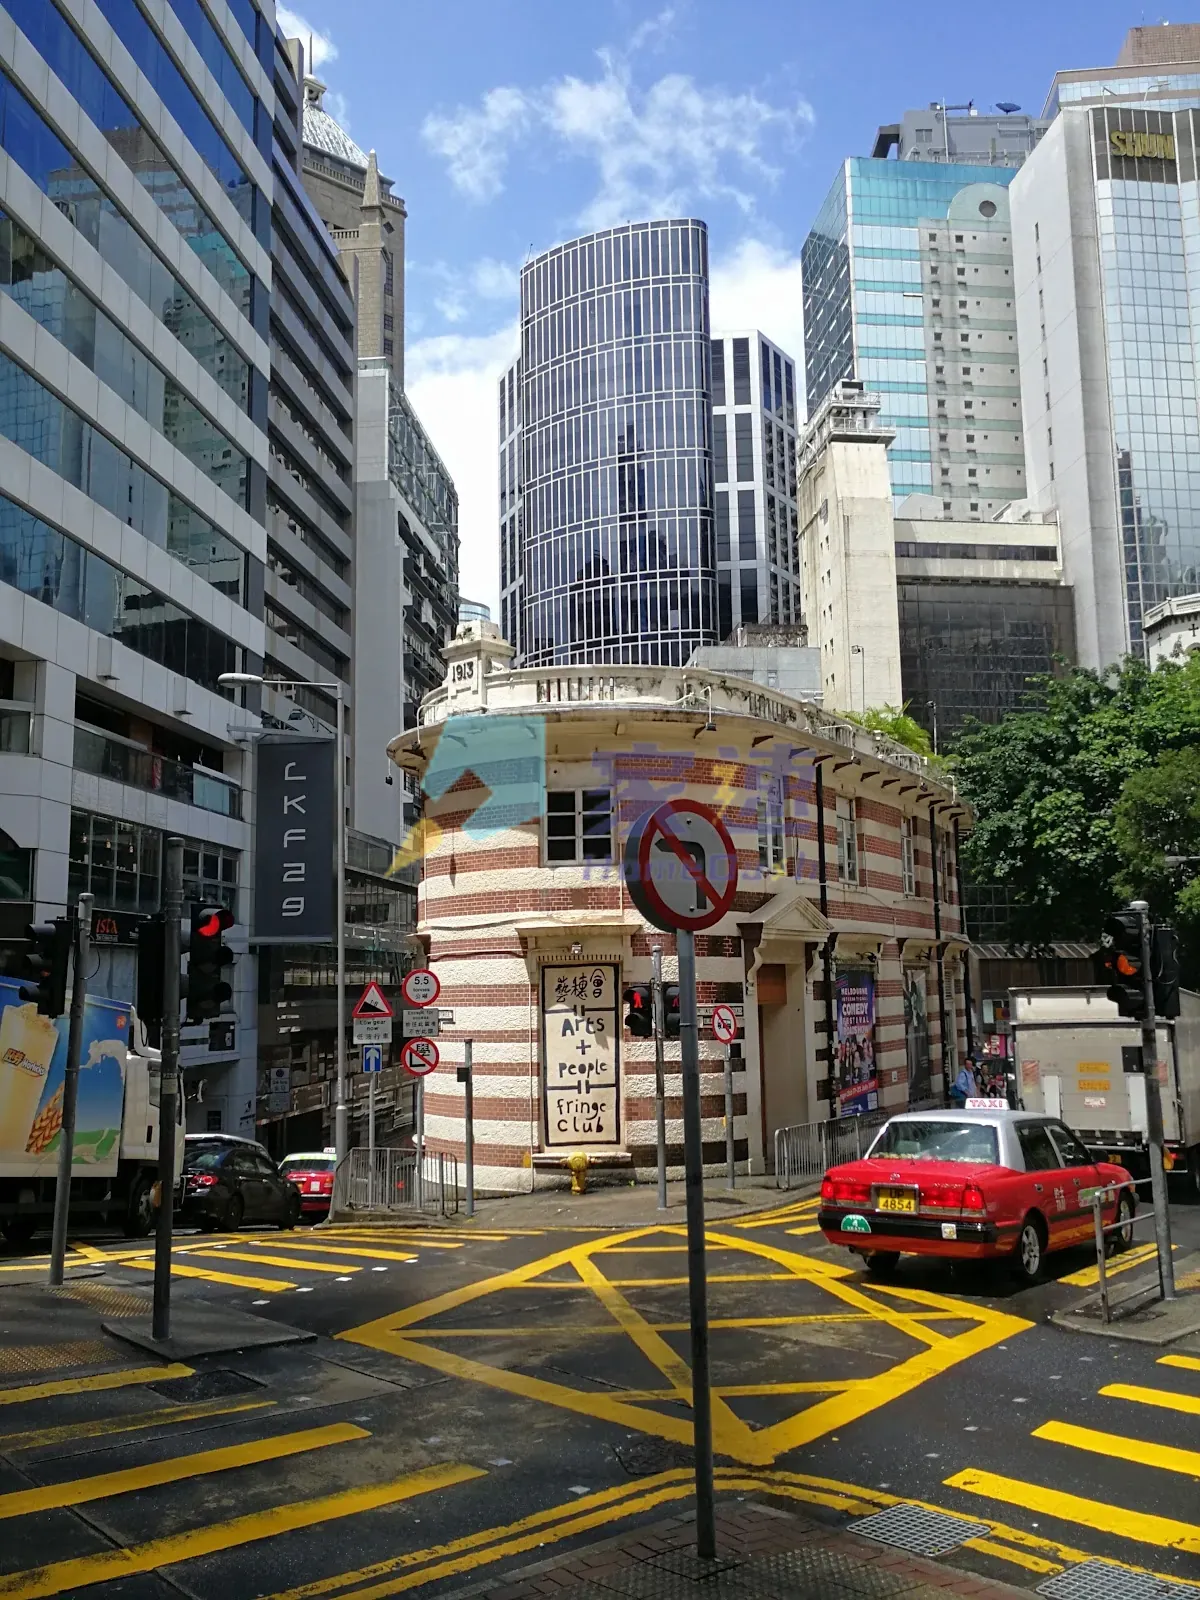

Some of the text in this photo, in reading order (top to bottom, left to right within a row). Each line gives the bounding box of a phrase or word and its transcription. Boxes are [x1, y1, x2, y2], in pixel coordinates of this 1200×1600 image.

[1110, 130, 1175, 160] SHUN
[452, 661, 474, 683] 1913
[414, 976, 429, 985] 5.5
[554, 968, 607, 1003] 藝穗會
[842, 1002, 869, 1016] COMEDY
[561, 1017, 605, 1038] Arts
[969, 1099, 1003, 1108] TAXI
[882, 1199, 912, 1211] 4854
